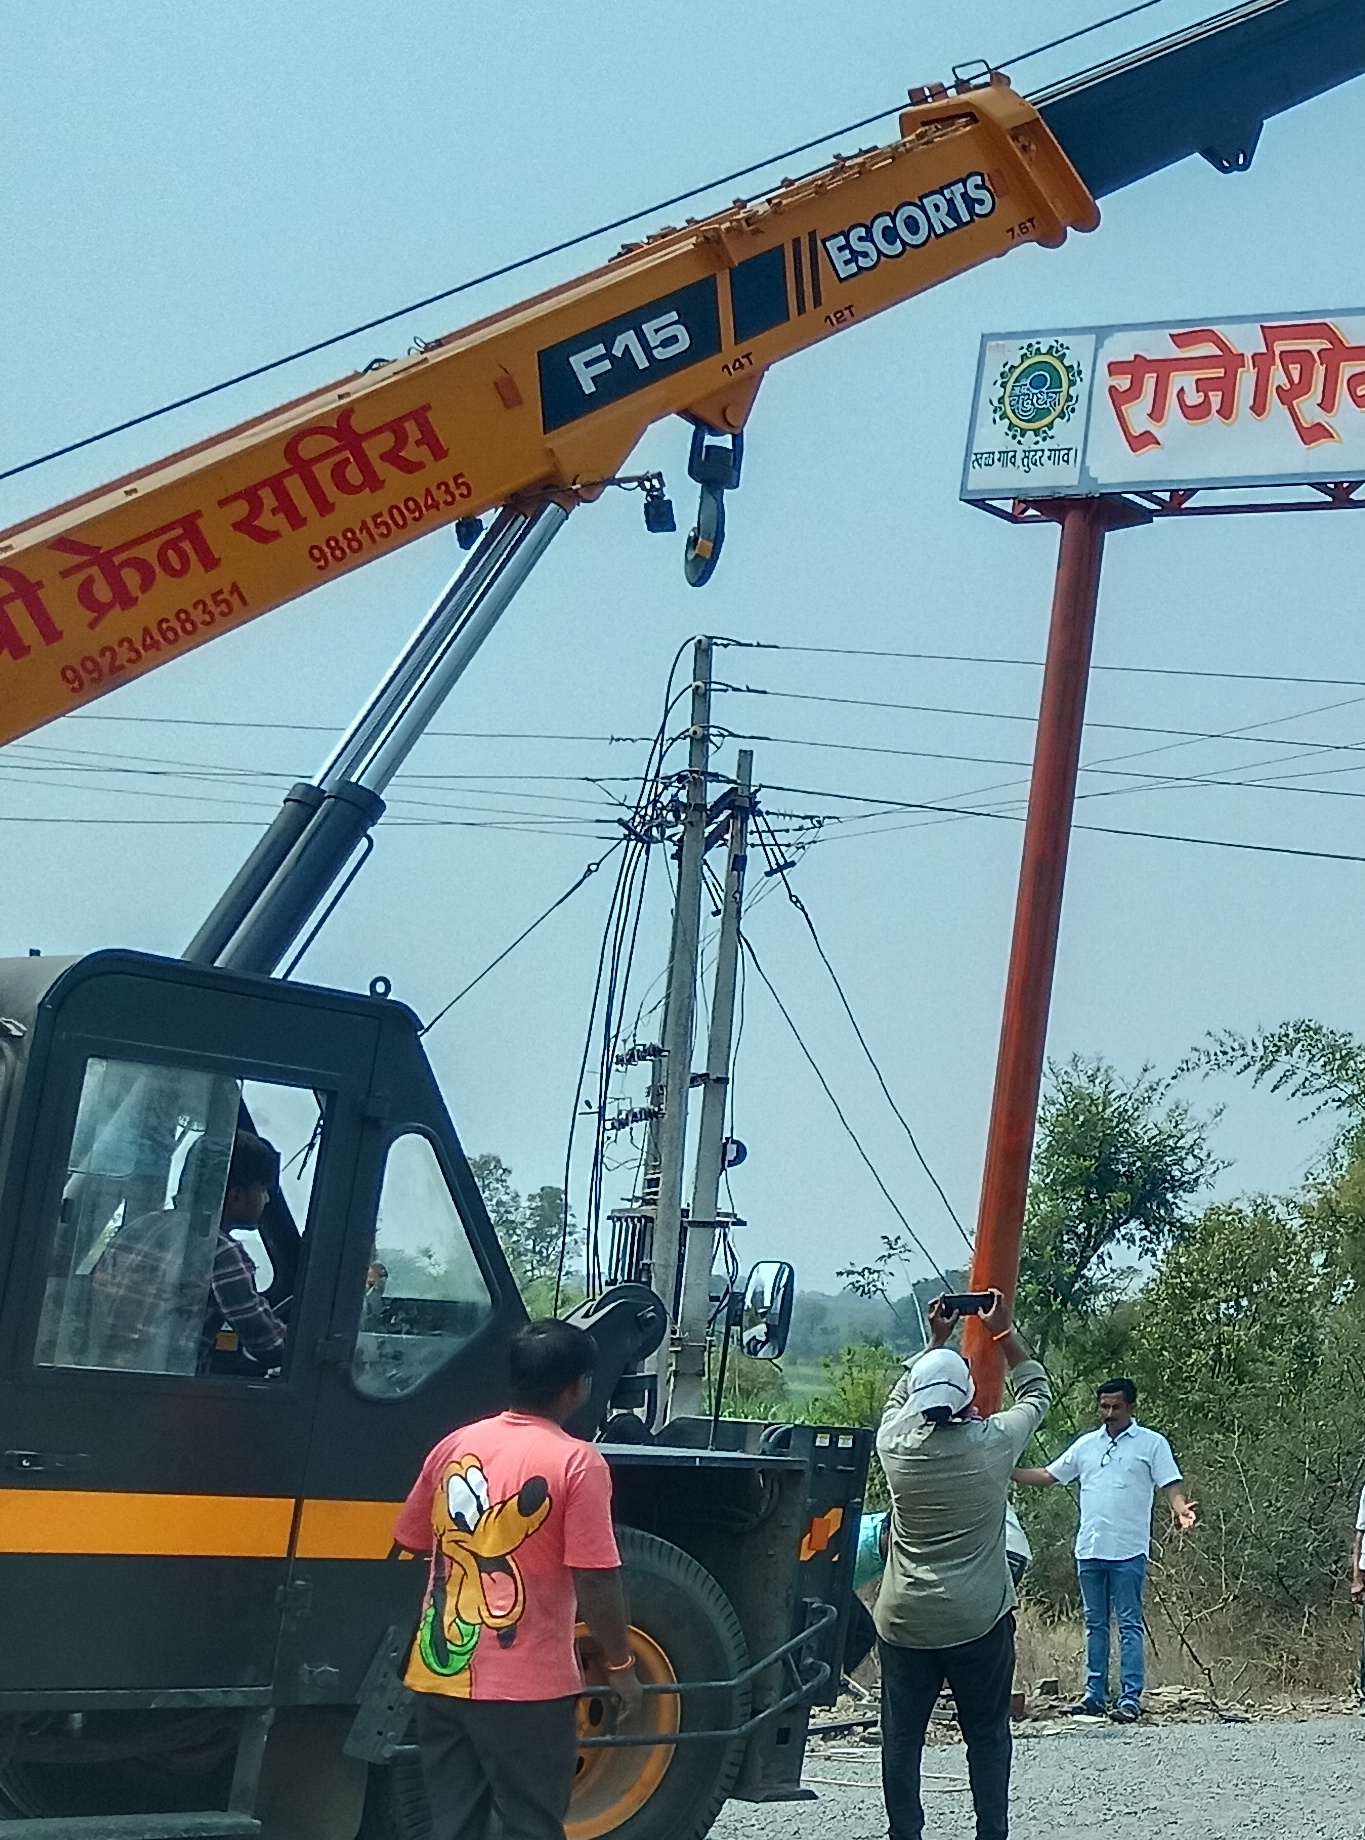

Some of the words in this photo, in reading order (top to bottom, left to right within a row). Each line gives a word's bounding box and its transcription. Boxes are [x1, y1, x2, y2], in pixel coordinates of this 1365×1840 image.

[823, 173, 996, 281] ESCORTS
[1006, 216, 1036, 240] 7.6T
[568, 309, 694, 395] F15
[721, 351, 753, 377] 14T
[1107, 325, 1246, 454] राजे
[47, 509, 221, 631] क्रेन
[217, 403, 450, 545] सर्विस
[307, 472, 474, 570] 9881509435
[60, 581, 250, 693] 9923468351
